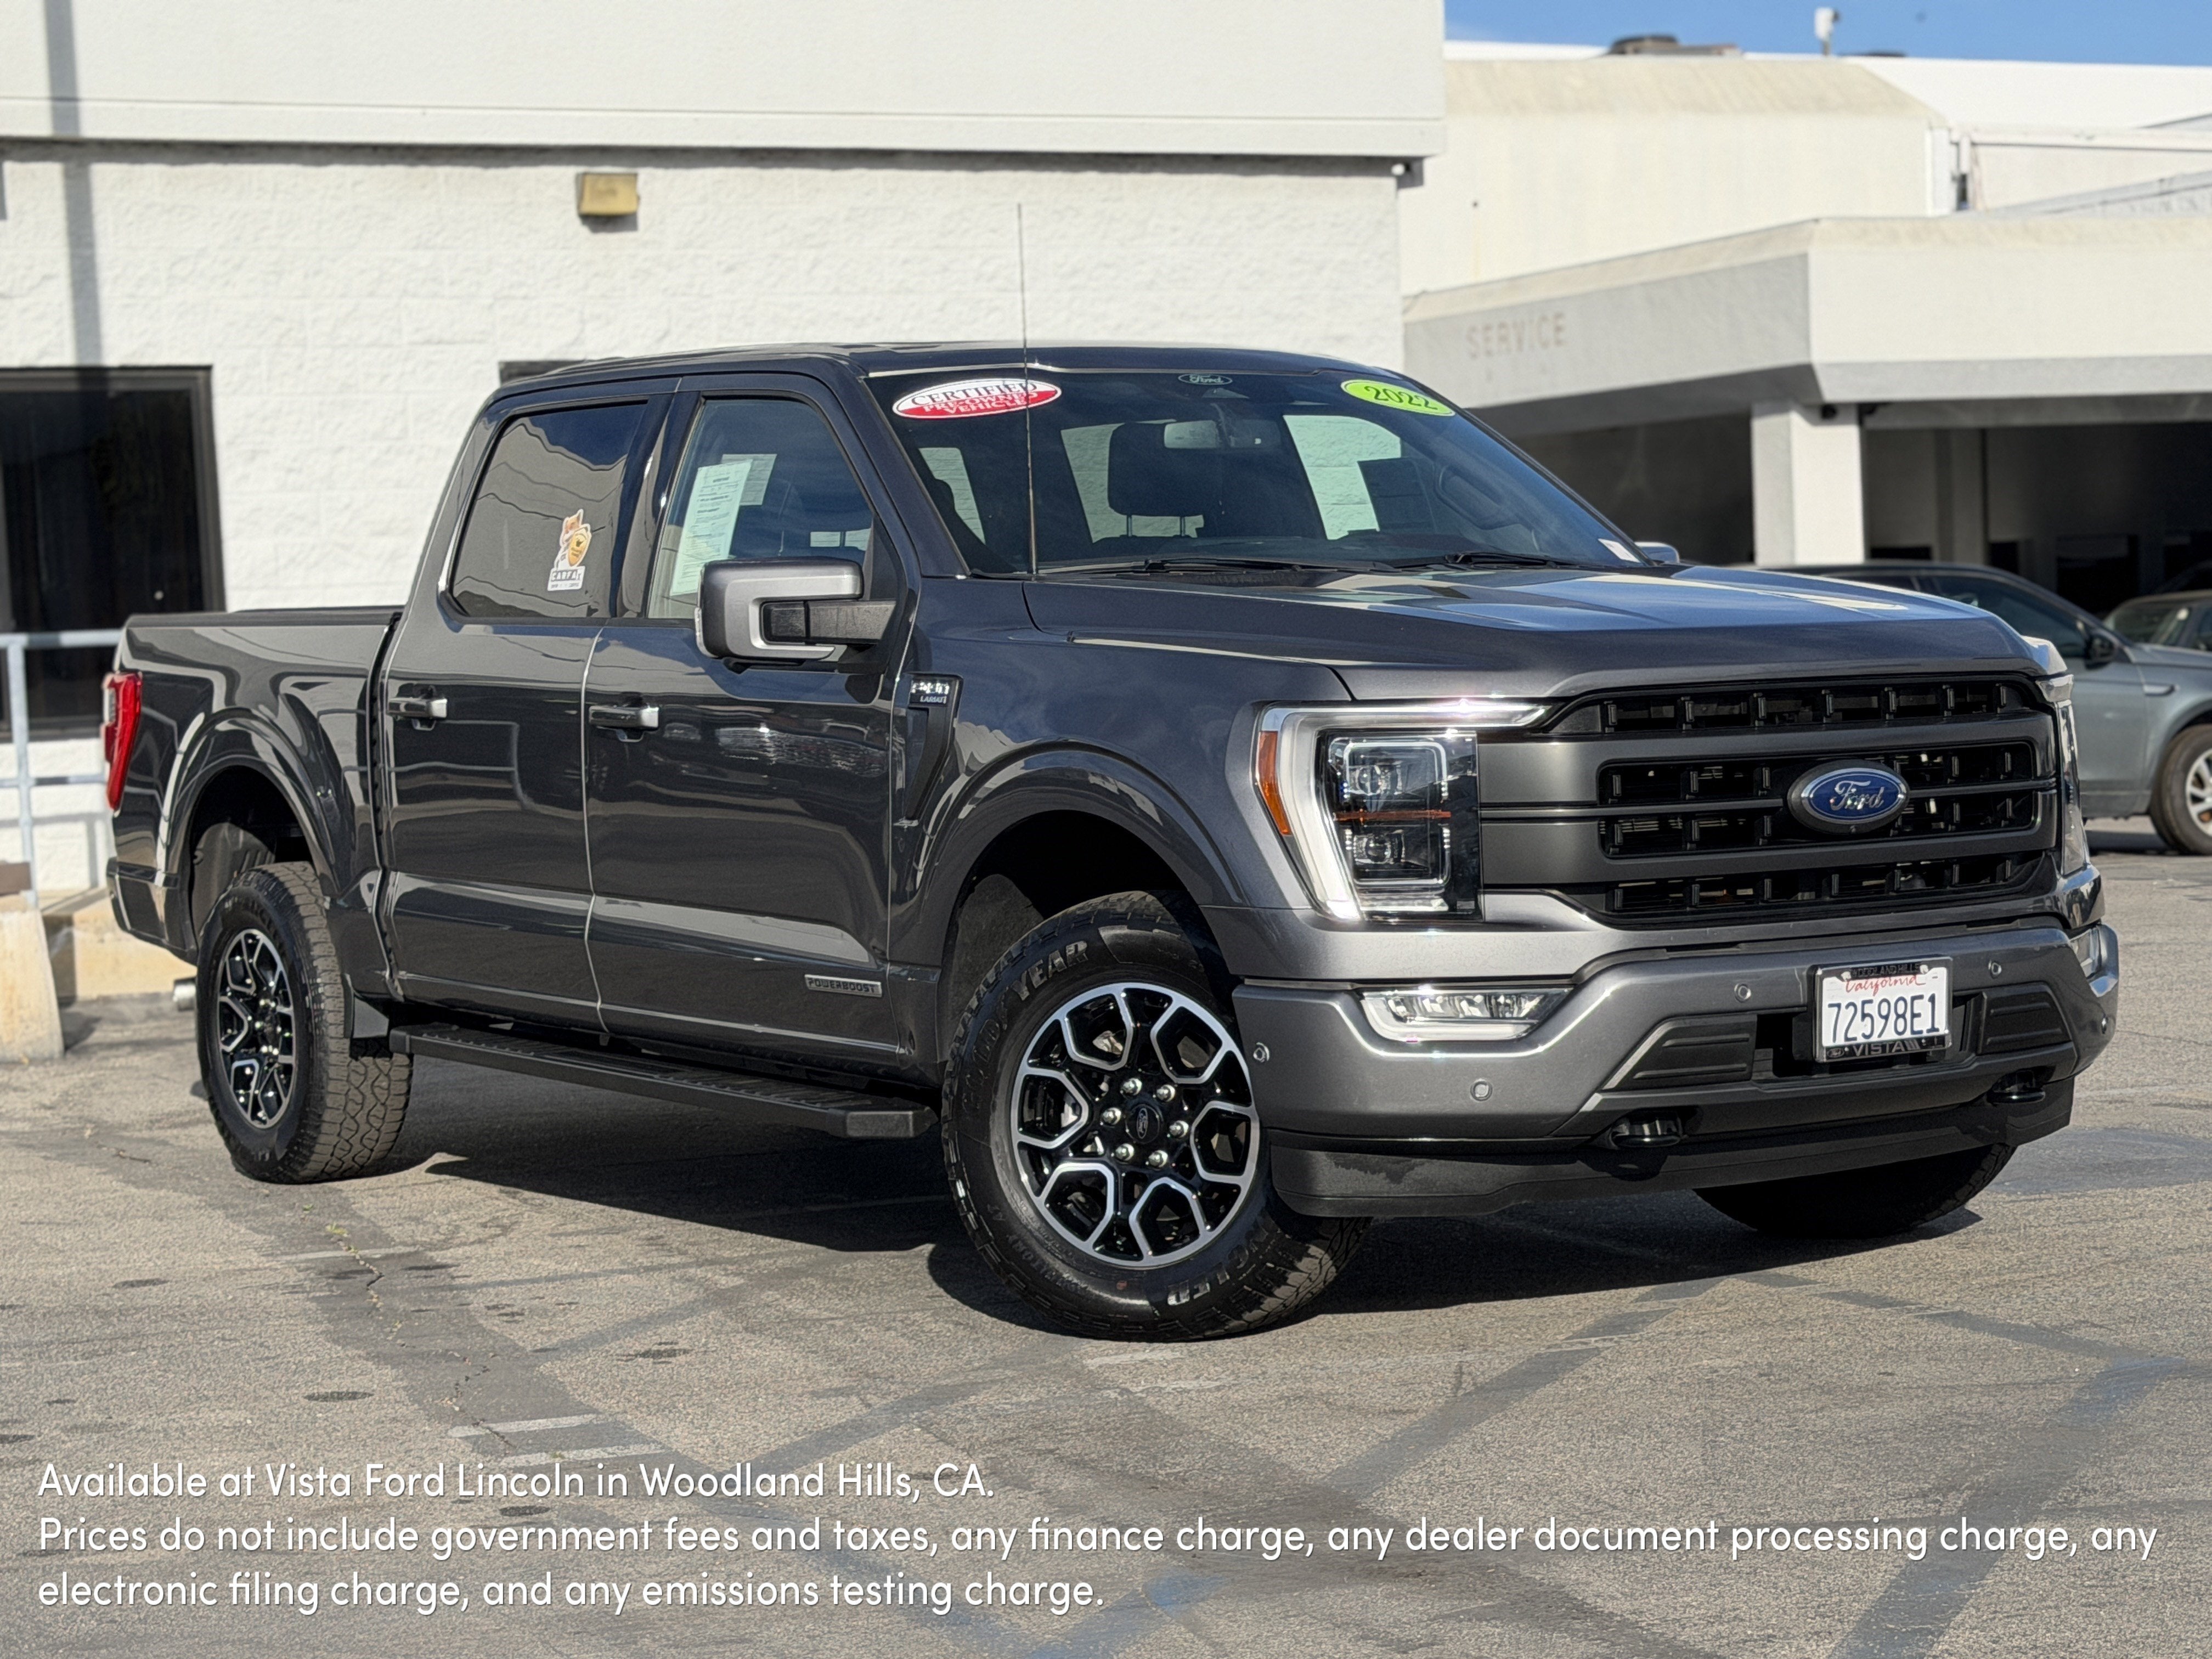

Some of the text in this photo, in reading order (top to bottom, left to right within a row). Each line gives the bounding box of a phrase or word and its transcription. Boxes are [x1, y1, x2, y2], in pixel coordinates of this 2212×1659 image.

[1466, 312, 1568, 361] SERVICE
[911, 382, 1037, 406] CERTIFIED
[924, 392, 1039, 412] PRE-OWNED
[1364, 386, 1438, 410] 2022
[945, 399, 1031, 414] VEHICLE
[1830, 780, 1884, 811] Ford
[808, 978, 876, 994] POWERBOOST
[1845, 975, 1926, 997] California
[1827, 992, 1940, 1043] 72598E1
[1853, 1040, 1906, 1057] VISTA
